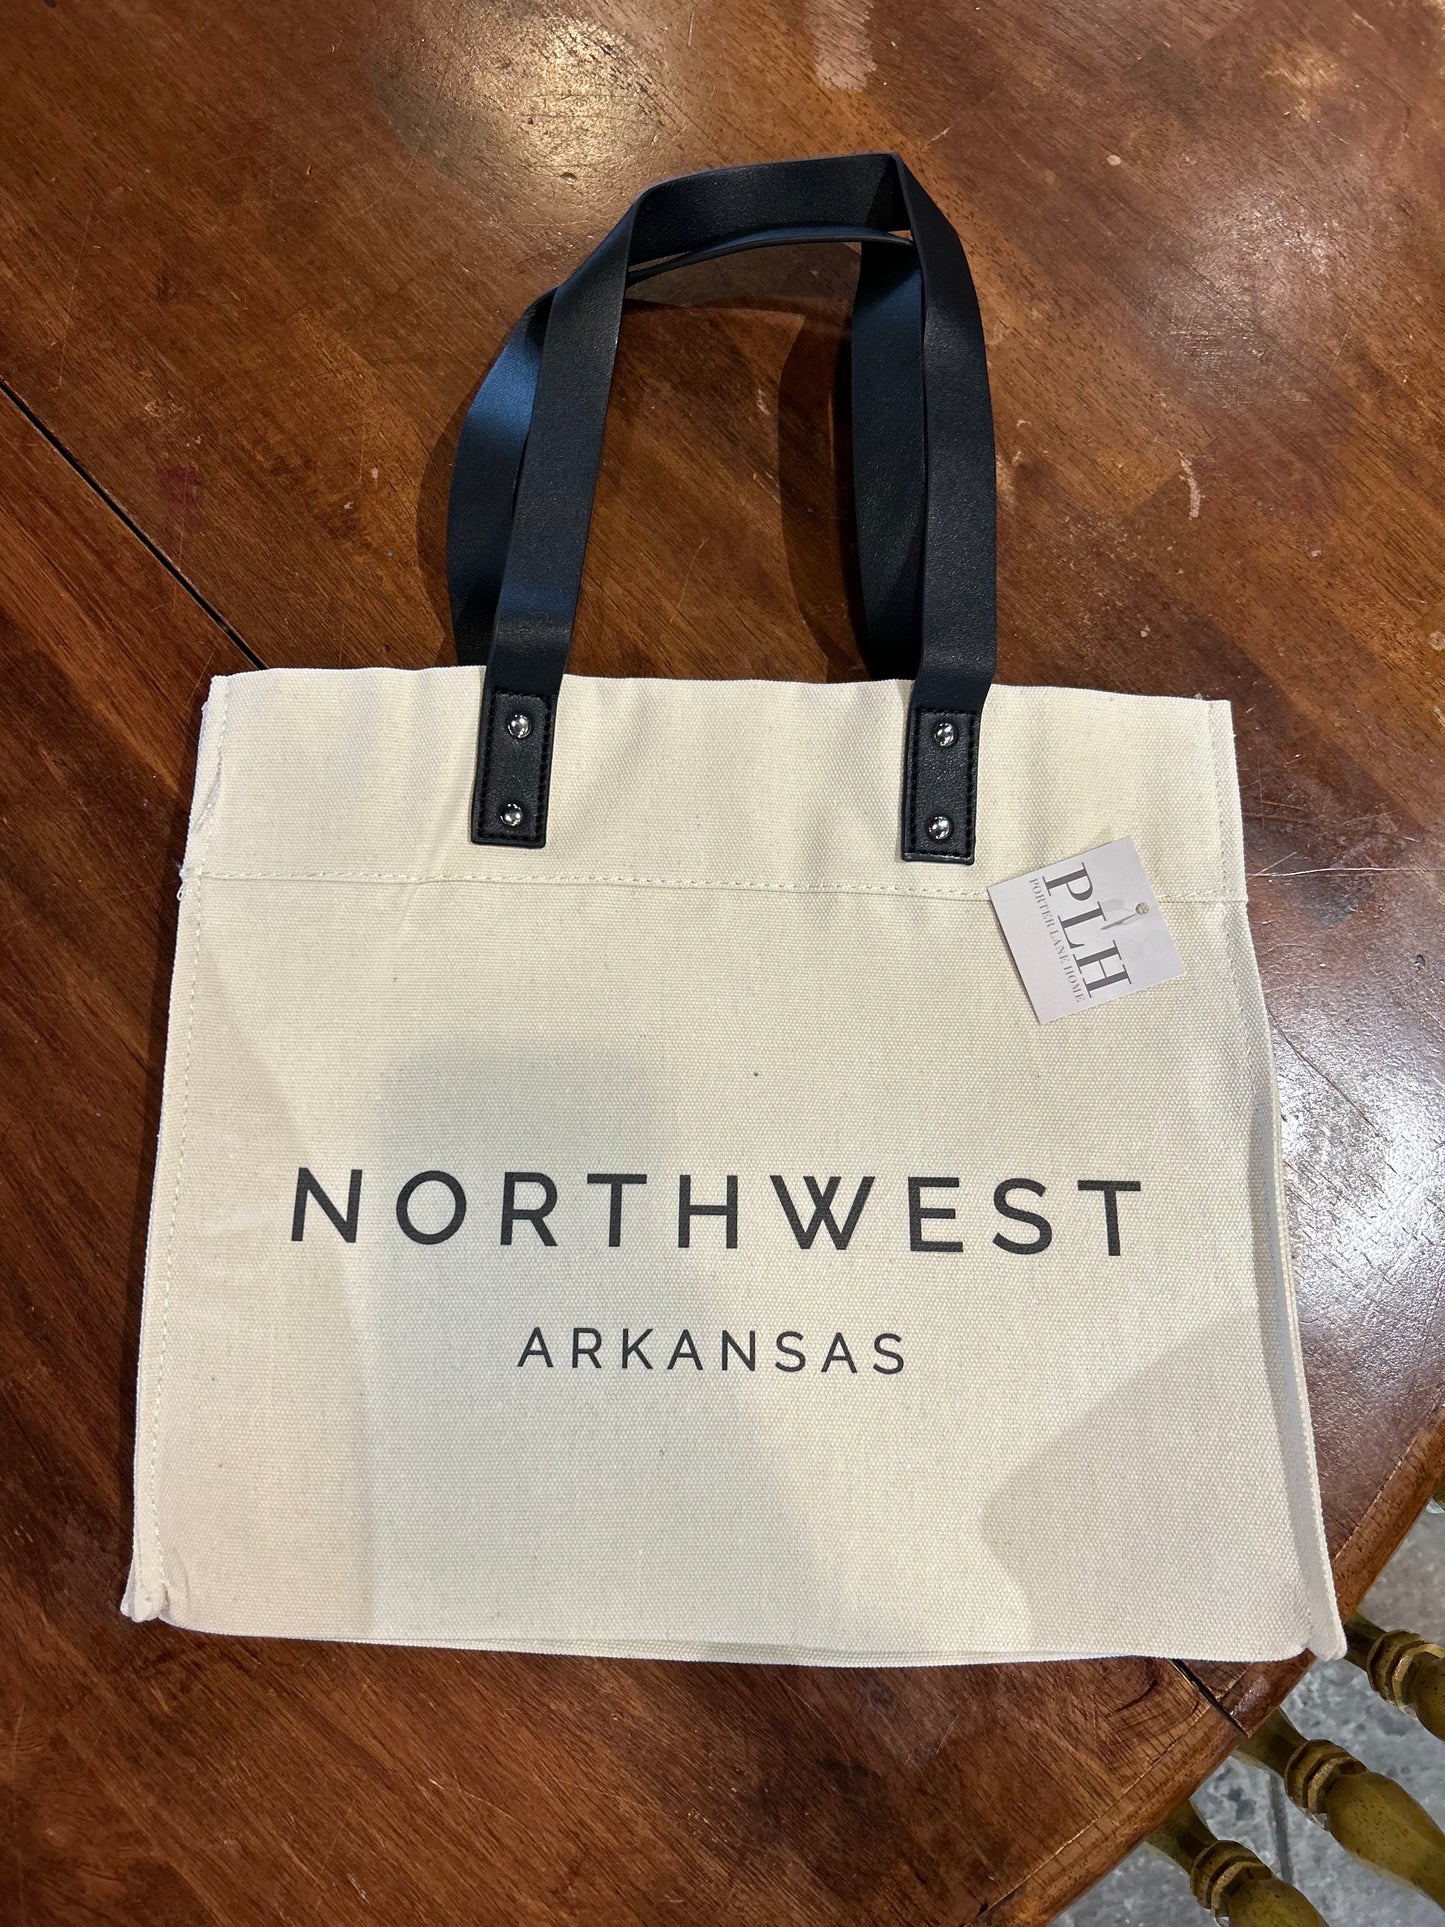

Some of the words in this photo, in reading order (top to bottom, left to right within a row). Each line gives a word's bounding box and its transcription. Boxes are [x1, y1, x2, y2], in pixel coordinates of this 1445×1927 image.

[1029, 878, 1055, 928] PORTER
[1049, 930, 1070, 964] LANE
[1063, 964, 1085, 1003] HOME
[1042, 862, 1132, 999] PLH
[290, 1167, 1142, 1256] NORTHWEST
[517, 1326, 906, 1375] ARKANSAS
